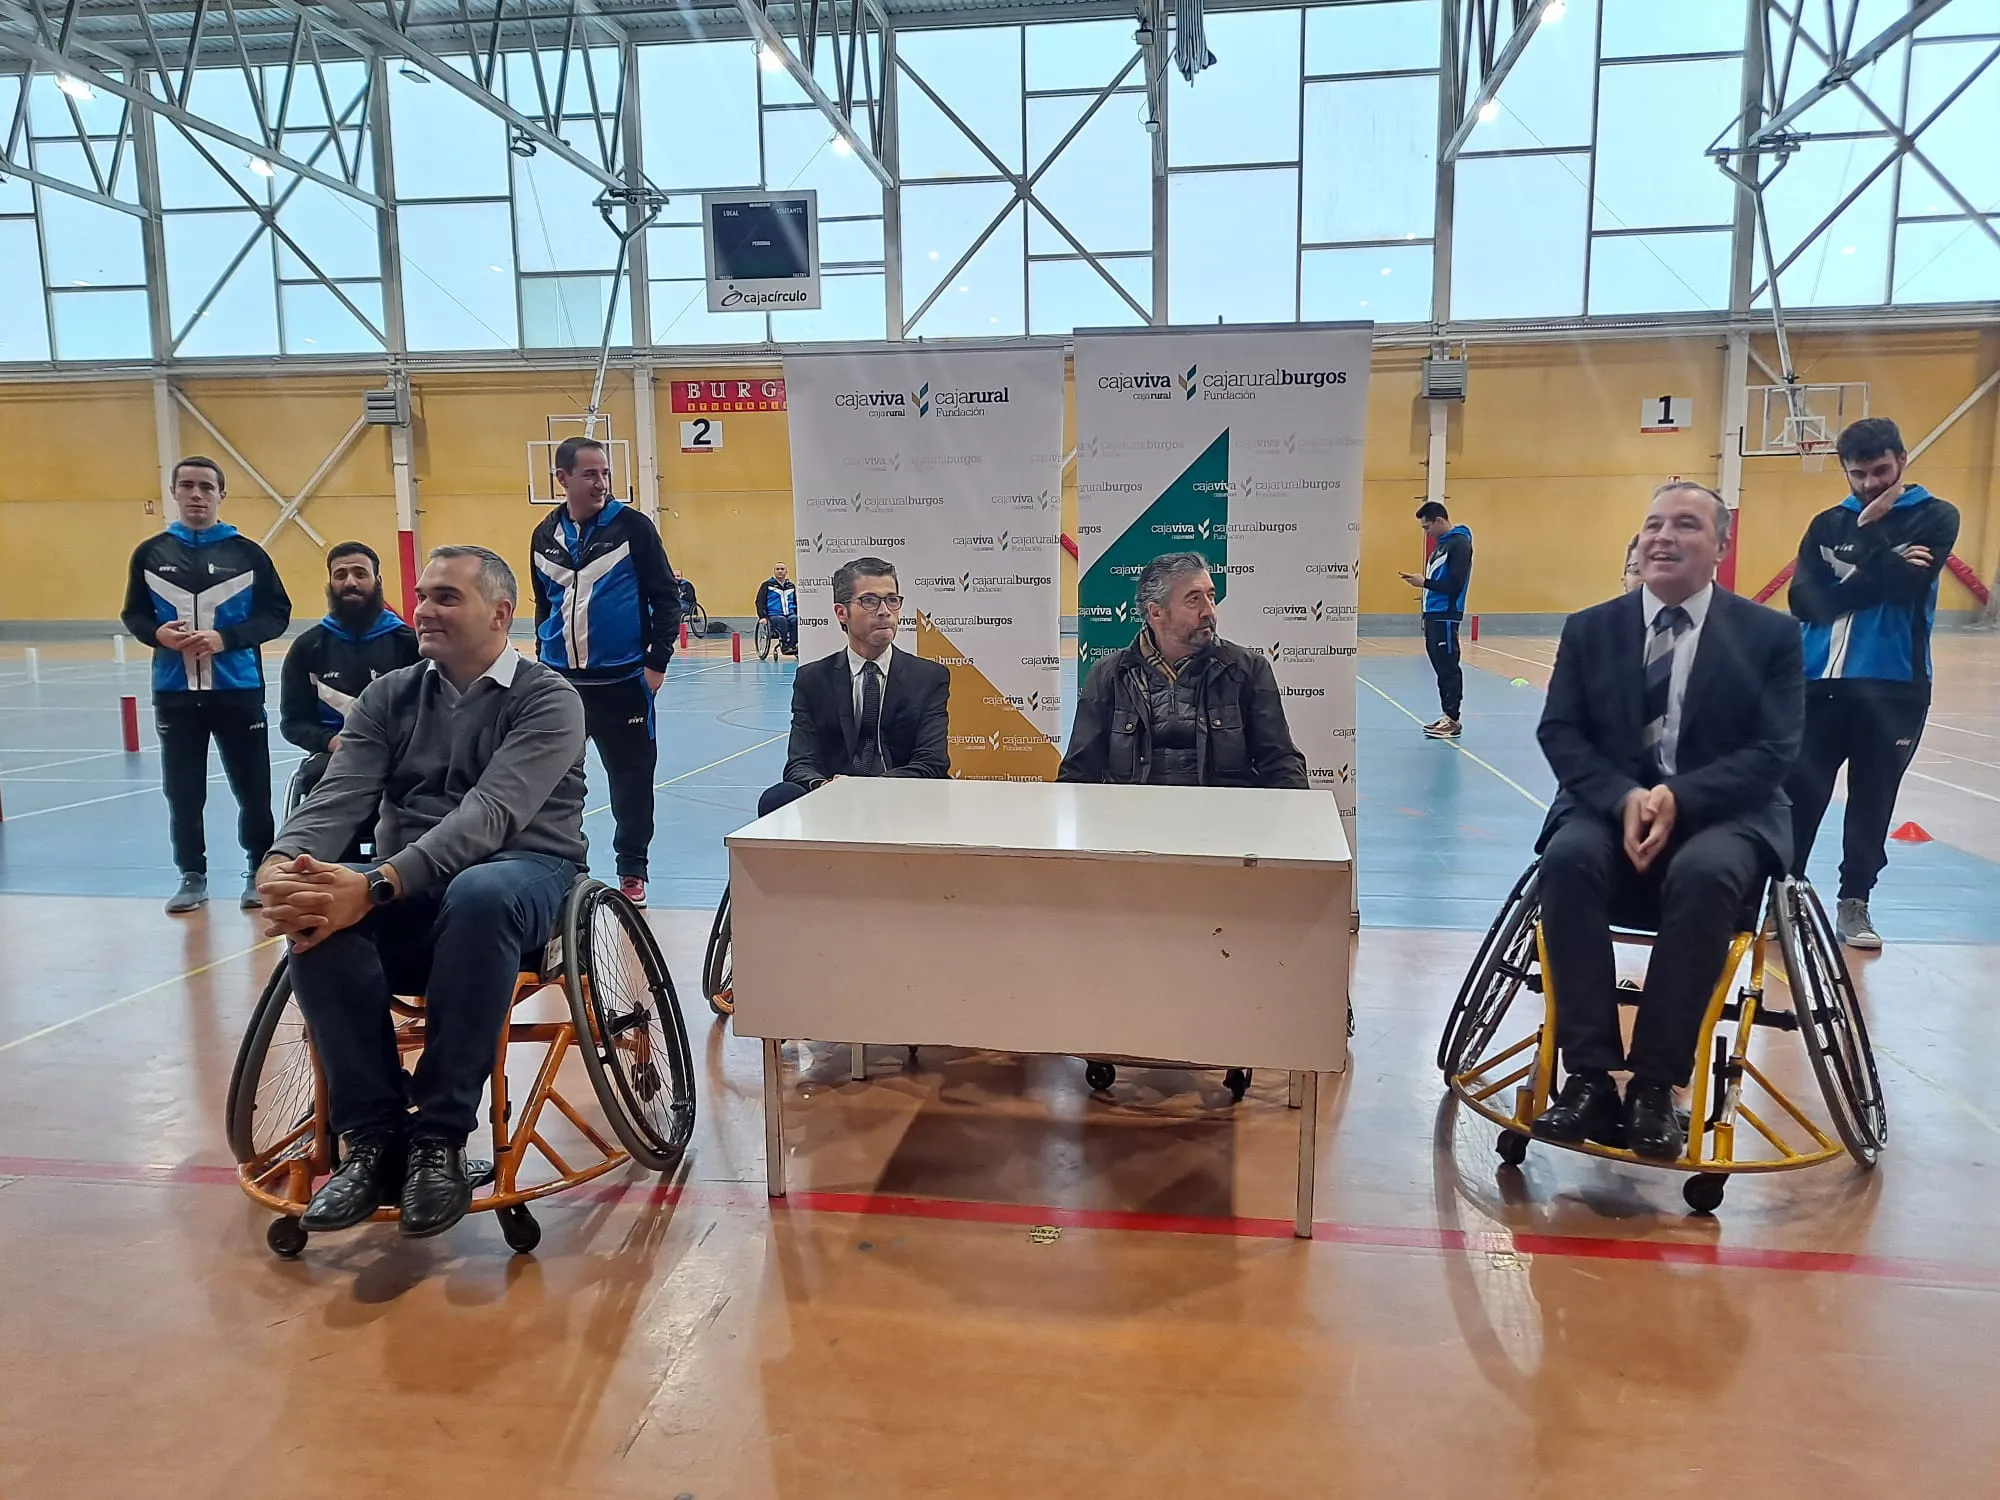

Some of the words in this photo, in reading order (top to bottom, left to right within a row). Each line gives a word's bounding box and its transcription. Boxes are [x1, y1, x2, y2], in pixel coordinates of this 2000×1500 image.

[744, 290, 807, 306] cajacírculo
[1098, 372, 1172, 393] cajaviva
[1202, 368, 1347, 389] cajaruralburgos
[687, 381, 777, 399] BURG
[1132, 391, 1172, 401] cajarural
[1203, 390, 1257, 401] Fundación
[834, 389, 906, 411] cajaviva
[935, 387, 1010, 409] cajarural
[868, 408, 906, 419] cajarural
[935, 406, 985, 418] Fundación
[1657, 395, 1675, 424] 1
[692, 418, 712, 446] 2
[1192, 479, 1238, 493] cajaviva
[1255, 477, 1341, 491] cajaruralburgos
[806, 495, 848, 508] cajaviva
[864, 495, 944, 508] cajaruralburgos
[991, 493, 1034, 505] cajaviva
[1151, 522, 1195, 535] cajaviva
[1212, 520, 1297, 533] cajaruralburgos
[825, 535, 906, 548] cajaruralburgos
[952, 534, 994, 547] cajaviva
[1305, 562, 1349, 575] cajaviva
[914, 575, 956, 588] cajaviva
[972, 574, 1052, 587] cajaruralburgos
[1263, 604, 1307, 617] cajaviva
[934, 615, 1013, 627] cajaruralburgos
[1021, 655, 1060, 667] cajaviva
[982, 694, 1024, 707] cajaviva
